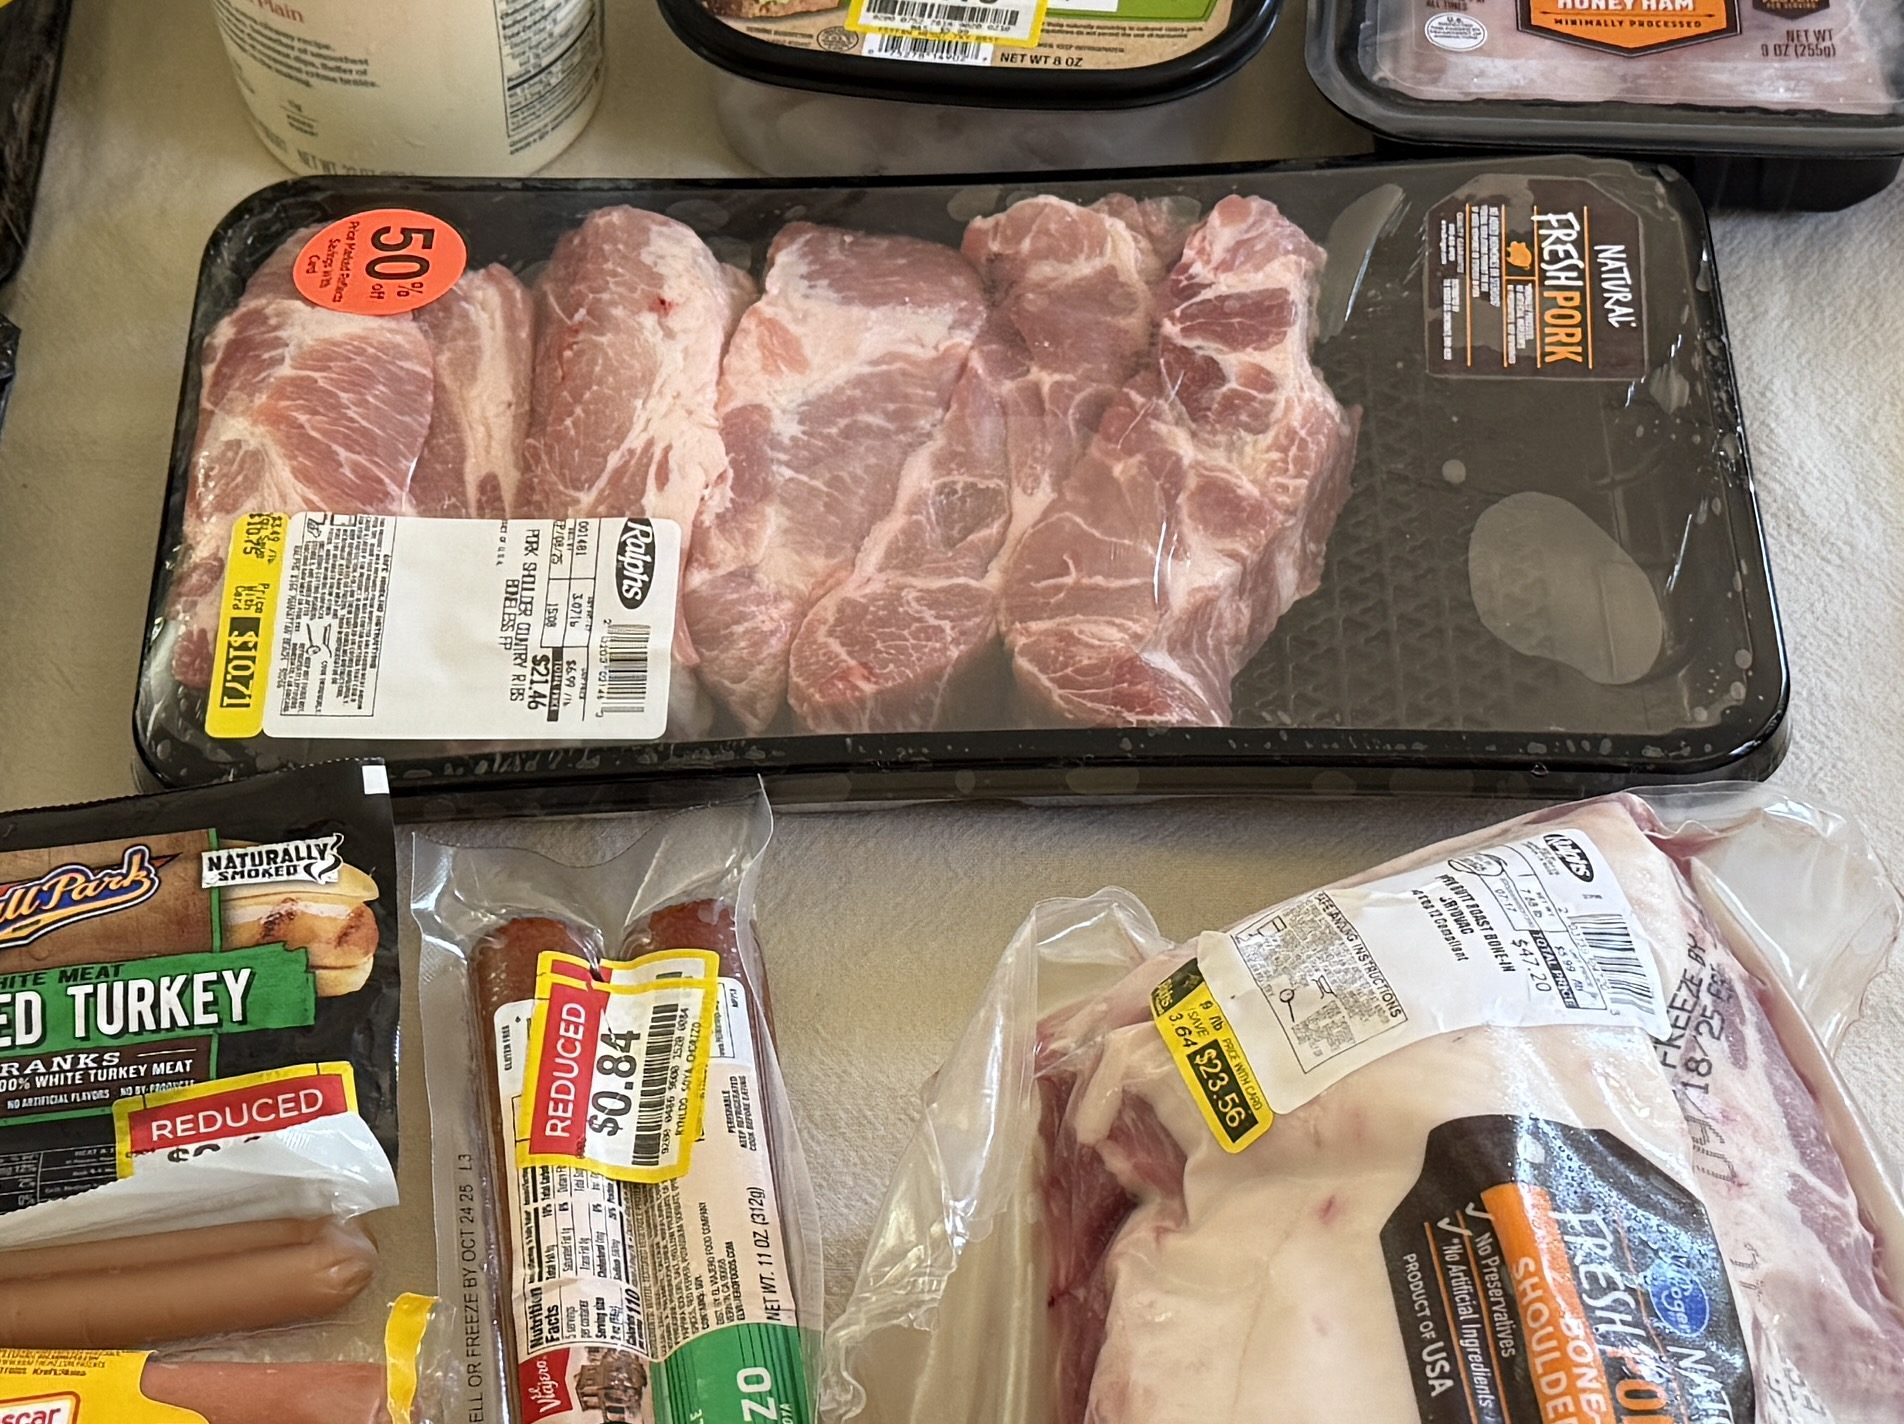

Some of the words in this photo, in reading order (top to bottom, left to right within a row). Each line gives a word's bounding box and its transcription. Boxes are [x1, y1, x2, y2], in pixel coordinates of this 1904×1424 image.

[1553, 18, 1624, 30] MINIMALLY
[1628, 17, 1703, 30] PROCESSED
[1532, 211, 1584, 288] FRESH
[1544, 290, 1583, 363] PORK
[618, 522, 653, 600] Ralphs
[527, 654, 550, 710] $21.46
[49, 846, 158, 911] Park
[206, 841, 330, 873] NATURALLY
[216, 864, 300, 882] SMOKED
[58, 963, 125, 985] MEAT
[66, 967, 254, 1039] TURKEY
[542, 1001, 587, 1139] REDUCED
[587, 1027, 641, 1138] $0.84
[1192, 1047, 1247, 1130] $23.56
[150, 1087, 325, 1143] REDUCED
[1474, 1233, 1492, 1257] No
[1484, 1257, 1516, 1358] Preservatives
